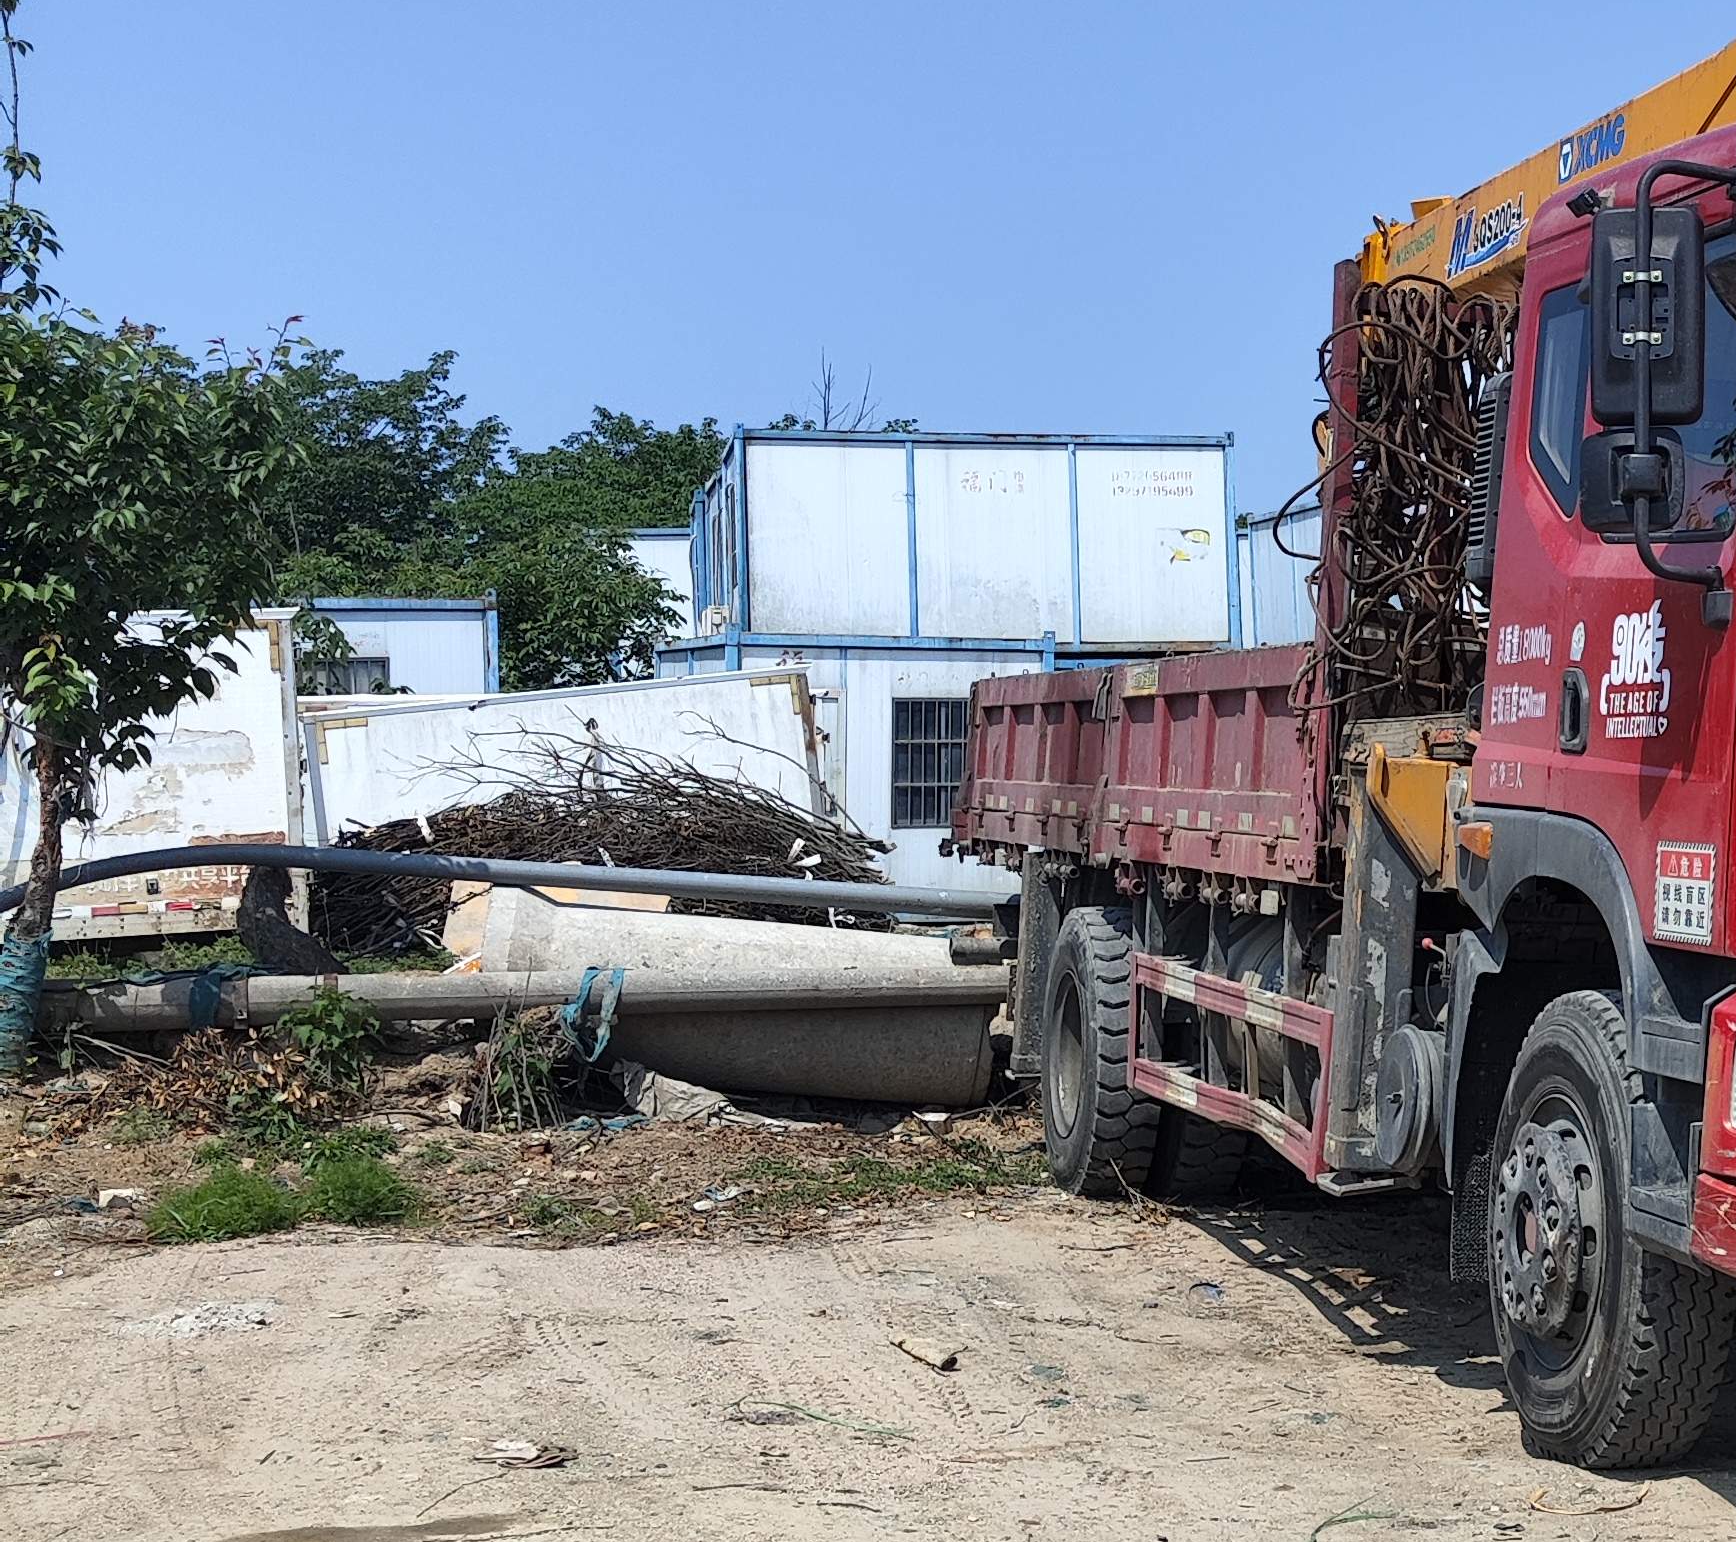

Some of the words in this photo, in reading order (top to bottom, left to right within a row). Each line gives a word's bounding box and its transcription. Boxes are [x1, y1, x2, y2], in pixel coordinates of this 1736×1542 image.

[1571, 113, 1625, 176] XCMG
[1609, 693, 1626, 714] THE
[1627, 692, 1646, 713] AGE
[1646, 690, 1660, 713] OF
[1605, 715, 1658, 739] INTELLECTUAL
[1679, 856, 1704, 878] 危险
[1661, 882, 1706, 906] 视线盲区
[1660, 908, 1706, 930] 请勿靠近
